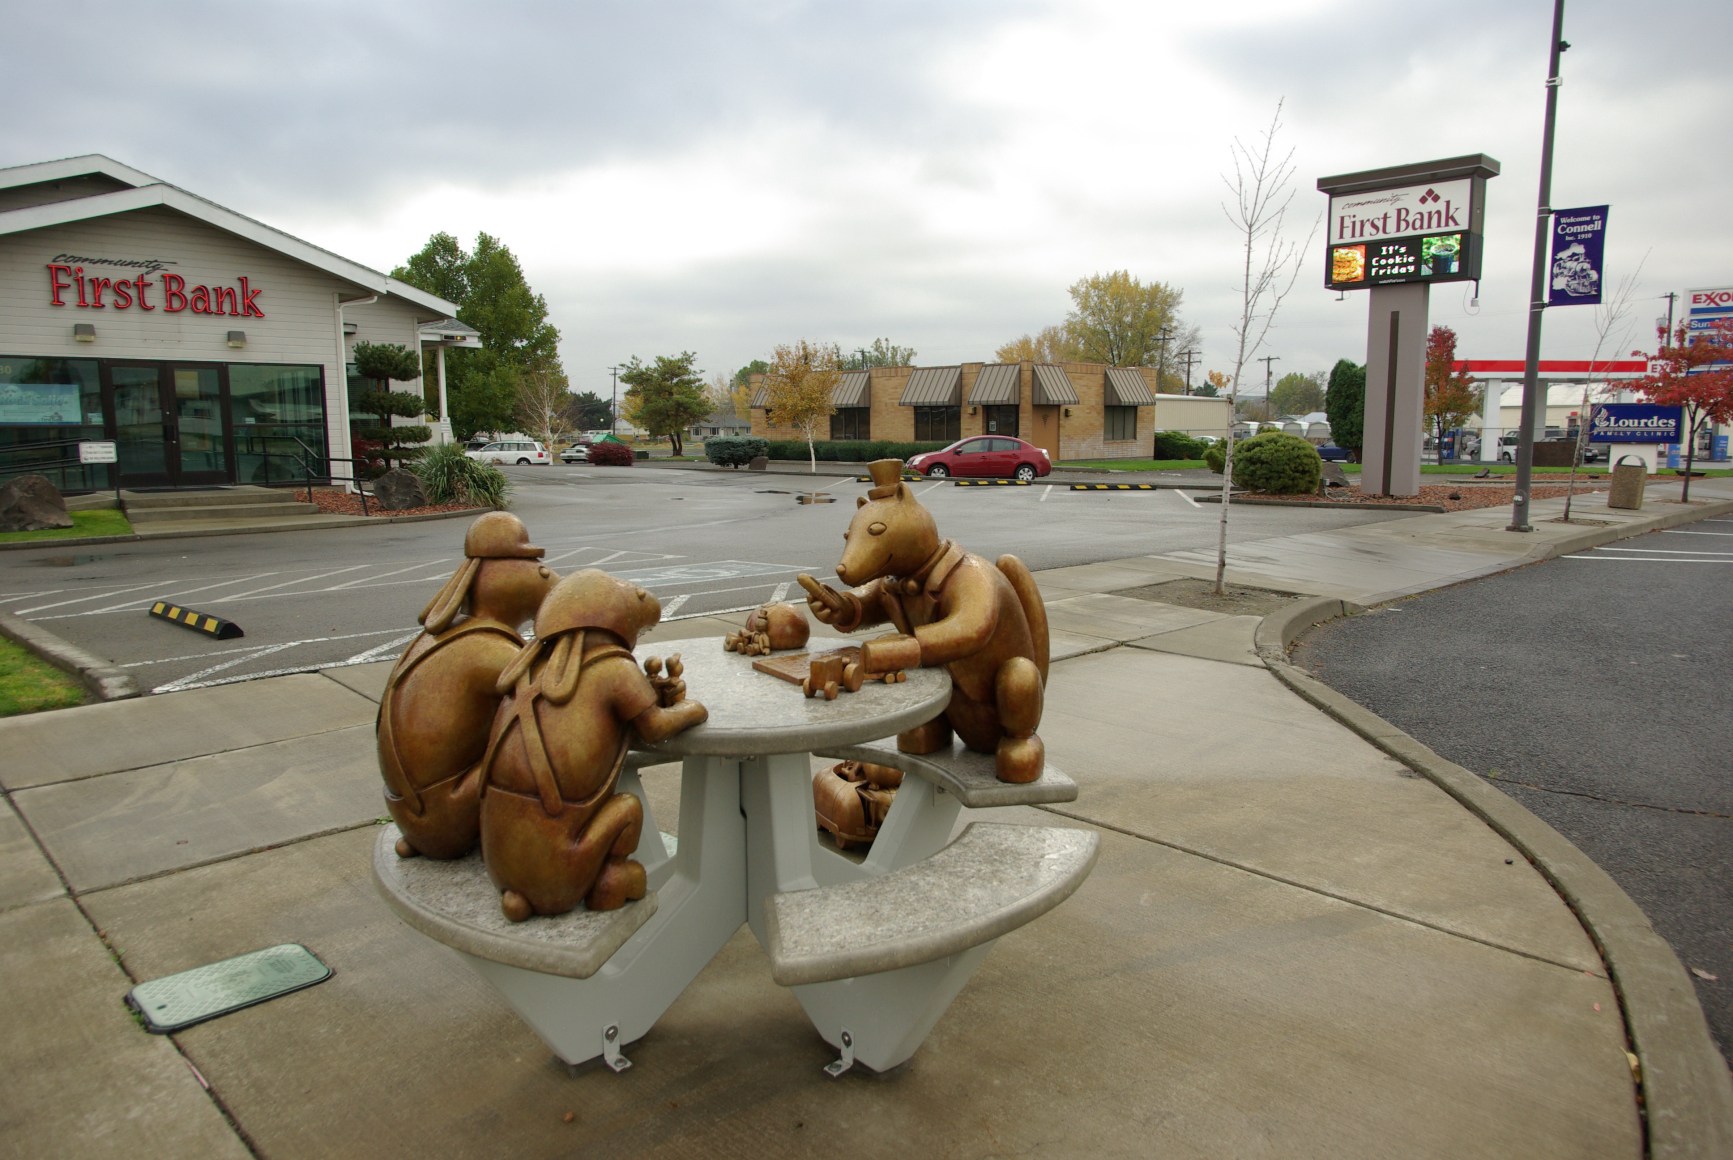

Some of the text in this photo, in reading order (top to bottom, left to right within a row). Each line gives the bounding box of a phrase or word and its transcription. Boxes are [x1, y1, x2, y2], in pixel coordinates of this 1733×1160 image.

[1342, 193, 1409, 210] community
[1557, 220, 1601, 235] Connell
[1381, 245, 1407, 255] It's
[52, 254, 177, 275] community
[1371, 255, 1415, 266] Cookie
[1371, 265, 1415, 276] Friday
[47, 264, 265, 317] First Bank
[1692, 291, 1733, 306] EXXO
[1609, 416, 1676, 427] Lourdes
